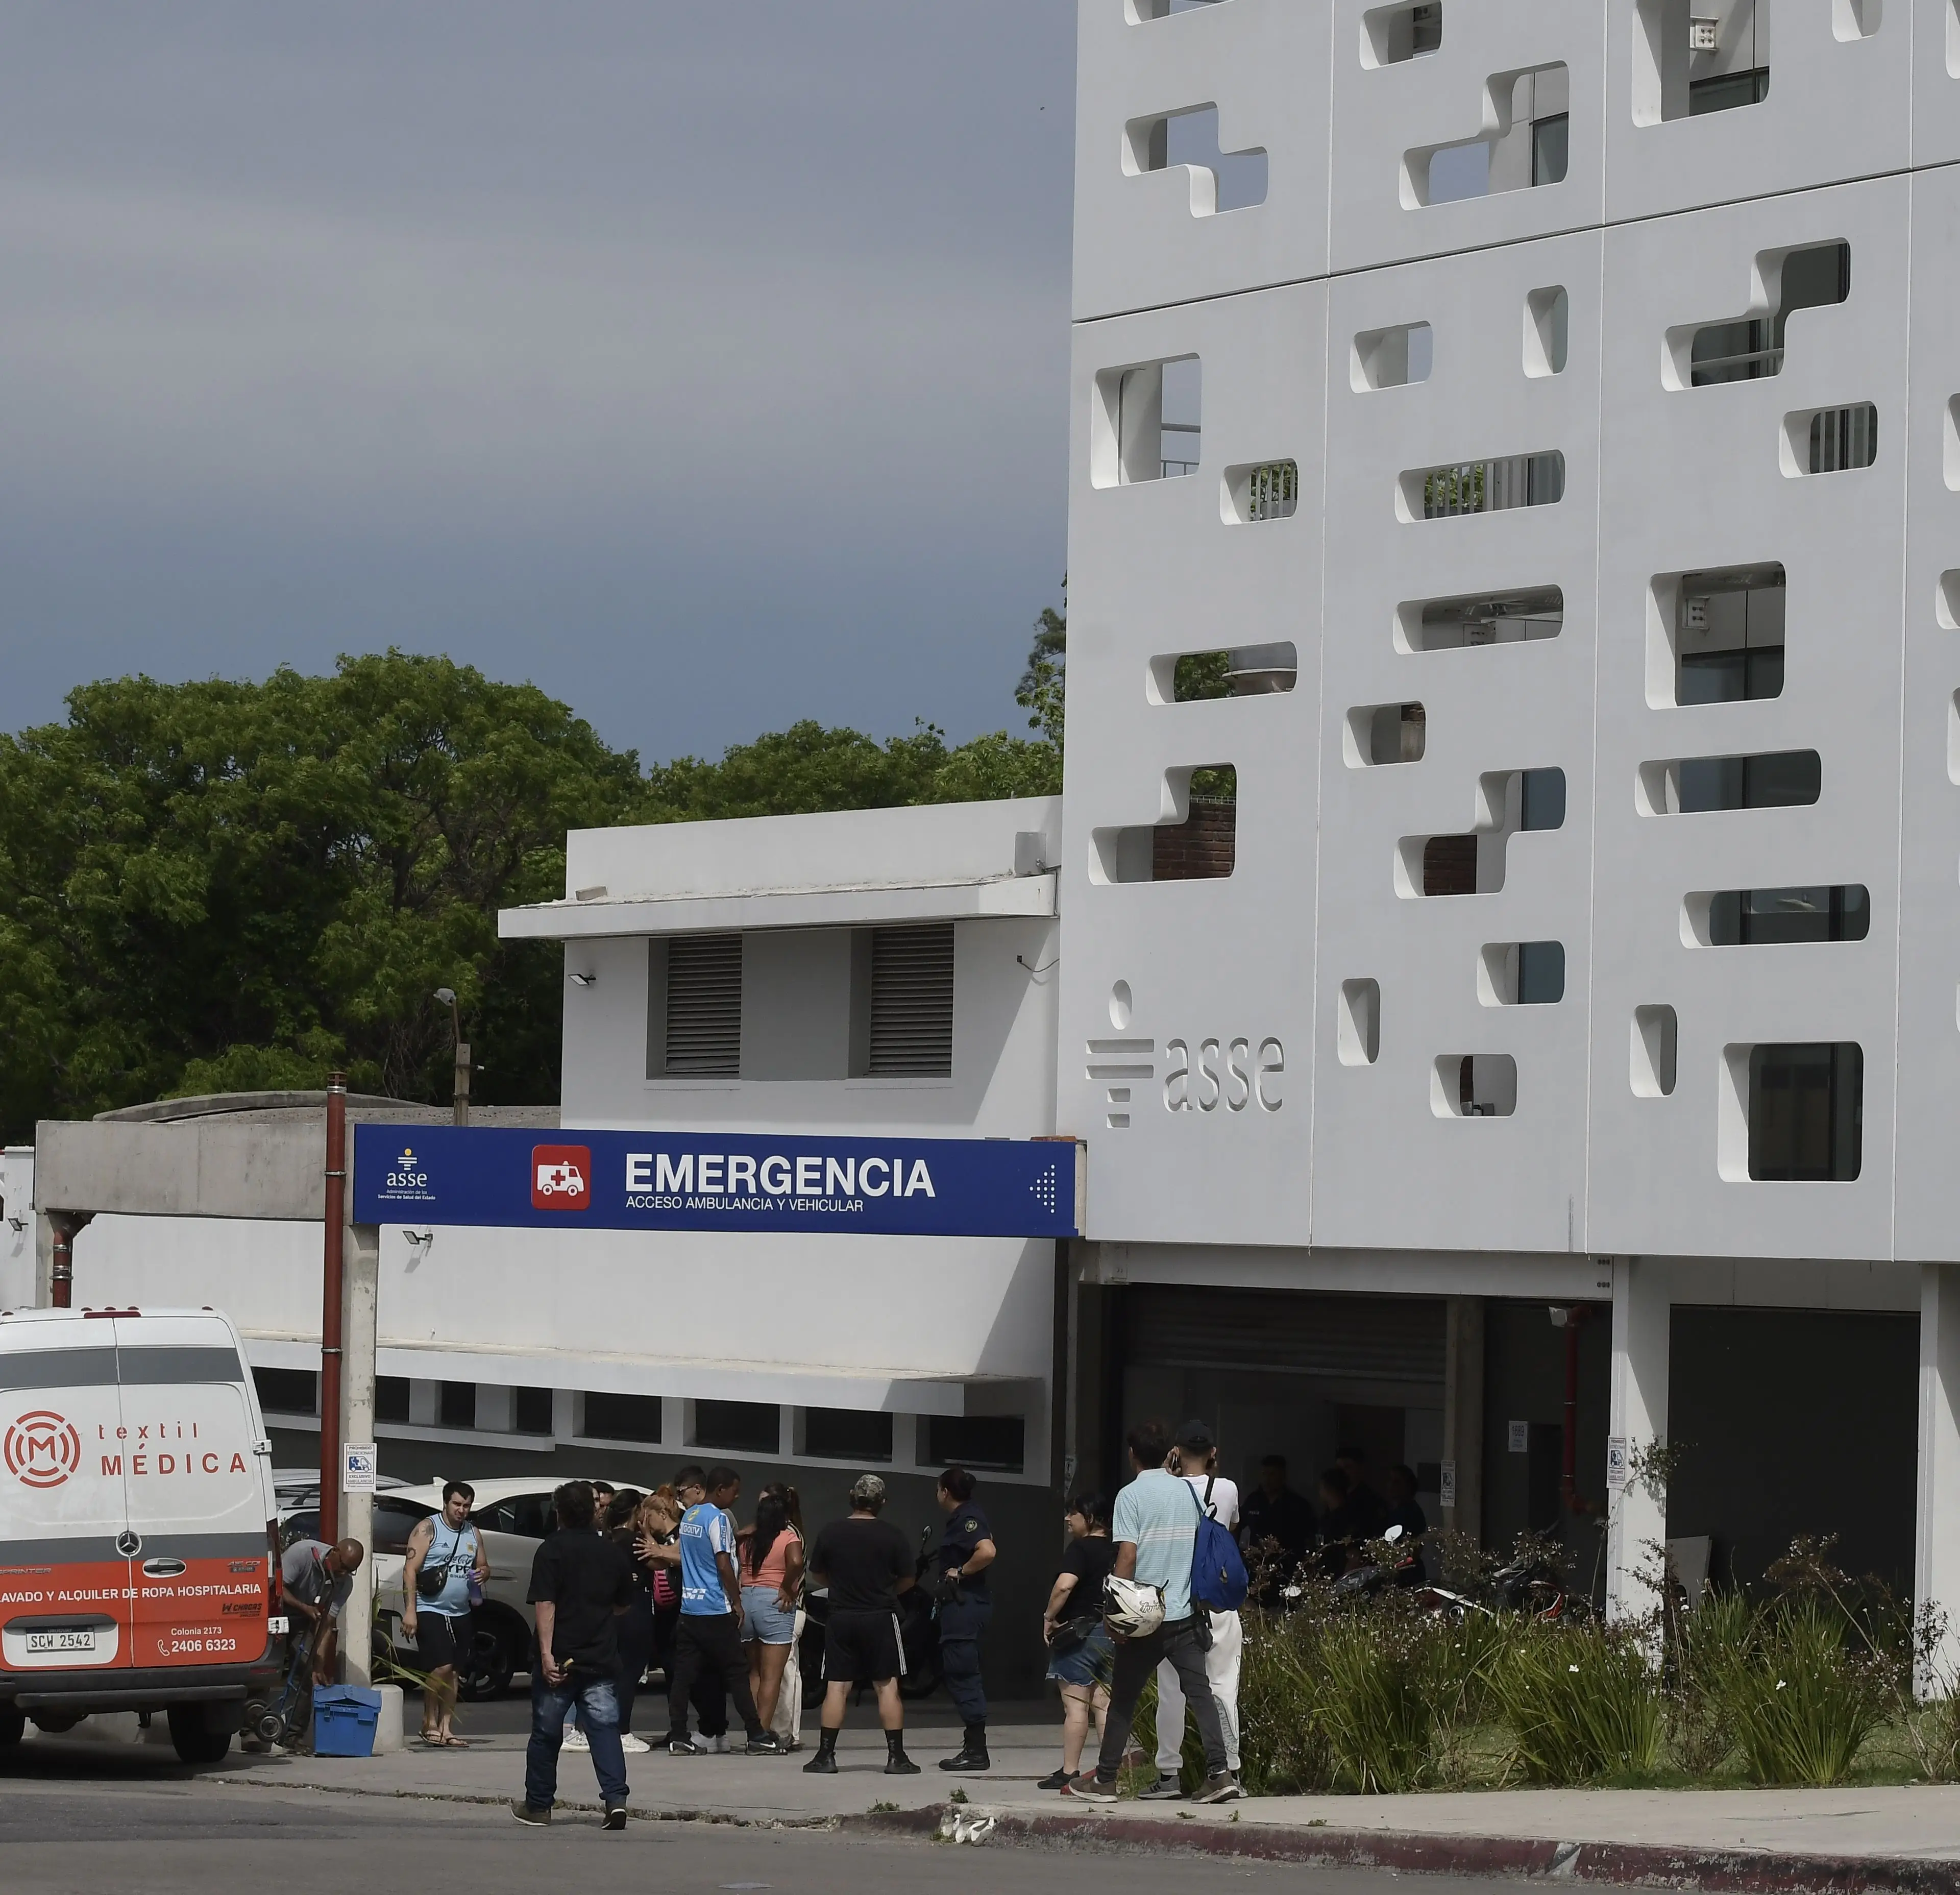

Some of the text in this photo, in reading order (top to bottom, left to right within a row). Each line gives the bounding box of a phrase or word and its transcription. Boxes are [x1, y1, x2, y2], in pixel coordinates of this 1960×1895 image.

[1163, 1037, 1284, 1112] asse
[386, 1172, 427, 1187] asse
[626, 1153, 936, 1198] EMERGENCIA
[626, 1196, 864, 1212] ACCESO AMBULANCIA Y VEHICULAR
[99, 1421, 198, 1440] textil
[101, 1443, 247, 1476] MÉDICA
[0, 1584, 261, 1603] AVADO Y ALQUILER DE ROPA HOSPITALARIA
[171, 1626, 222, 1636] Colonia 2173
[31, 1634, 90, 1648] SCW 2542
[172, 1638, 236, 1653] 2406 6323
